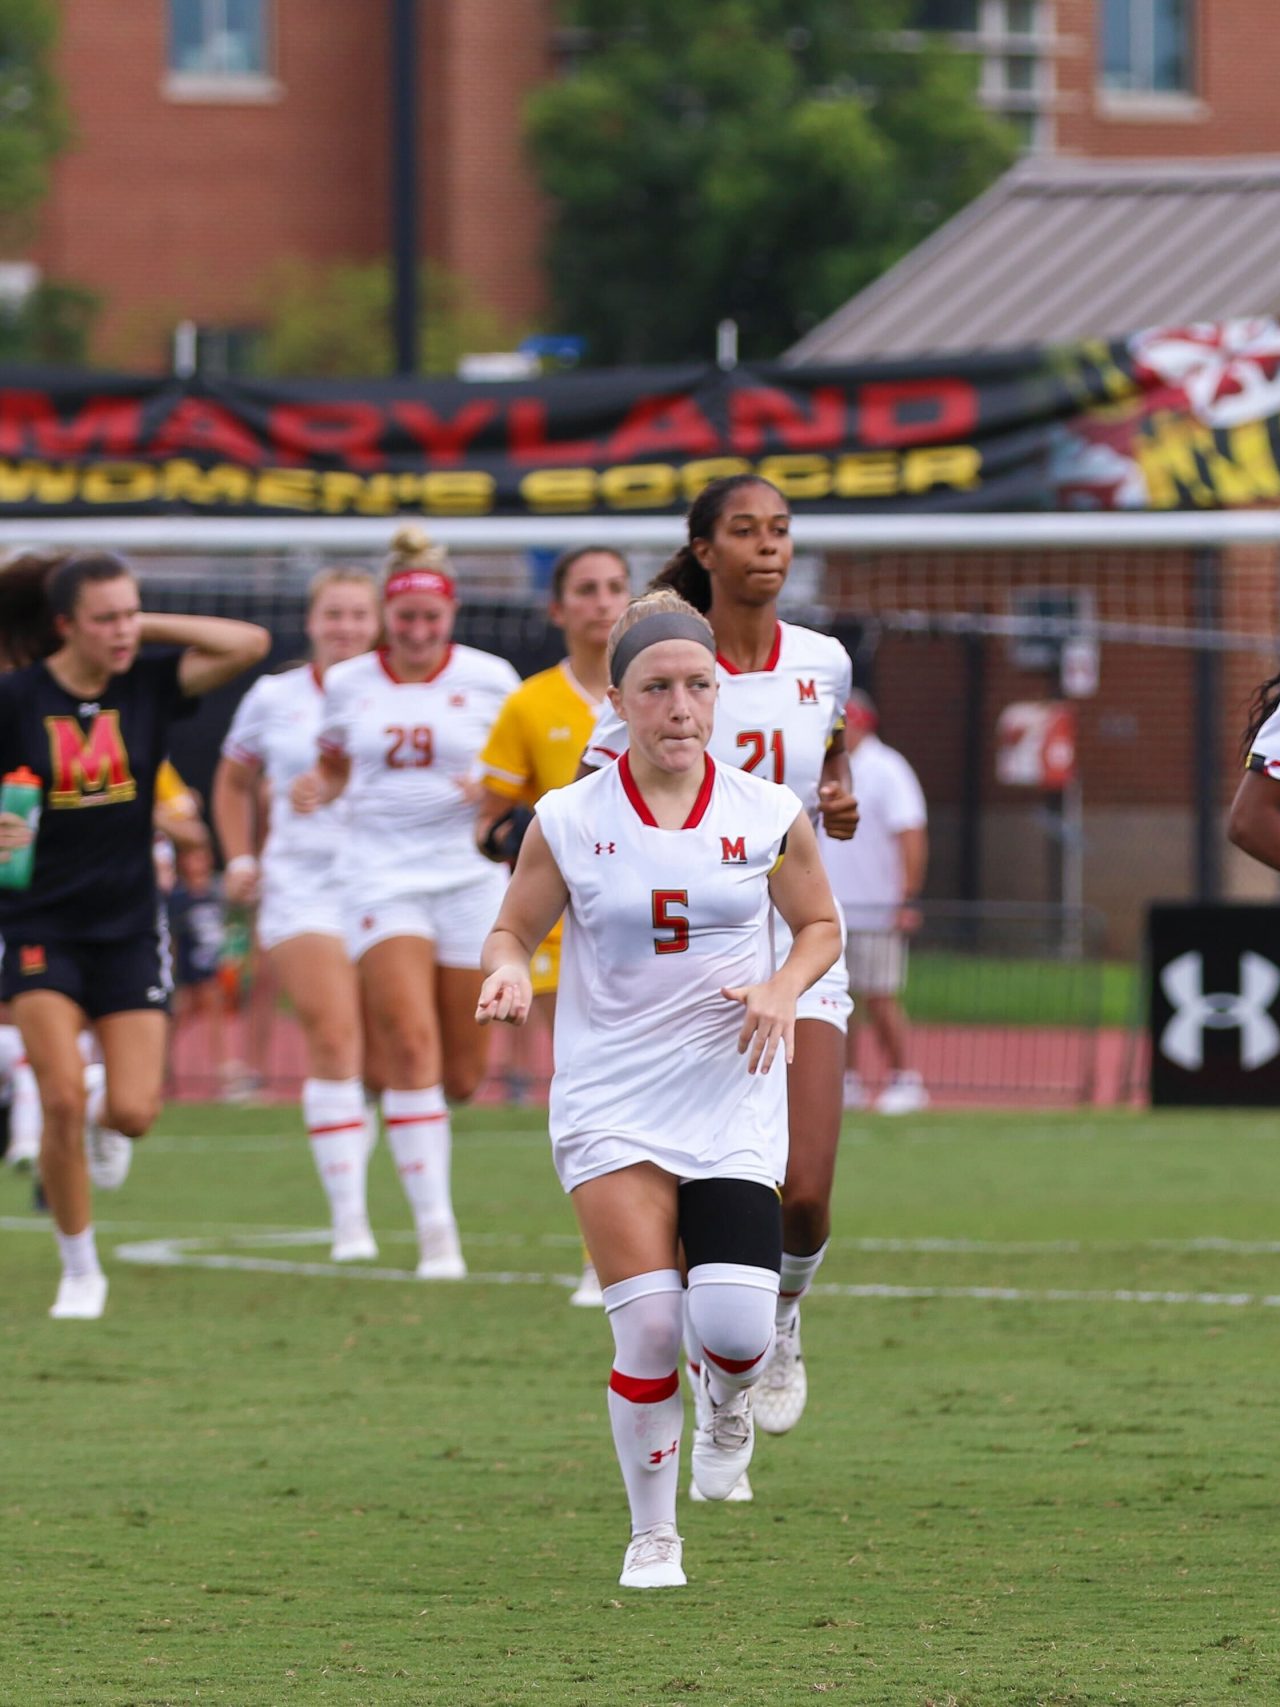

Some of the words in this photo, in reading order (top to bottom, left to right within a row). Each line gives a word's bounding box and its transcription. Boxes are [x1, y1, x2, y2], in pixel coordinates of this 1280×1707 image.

[0, 378, 977, 468] MARYLAND
[0, 458, 494, 515] WOMEN'S
[518, 446, 982, 512] SOCCER
[45, 709, 137, 809] M
[384, 726, 434, 768] 29
[736, 729, 785, 784] 21
[720, 837, 747, 864] M
[651, 889, 689, 955] 5
